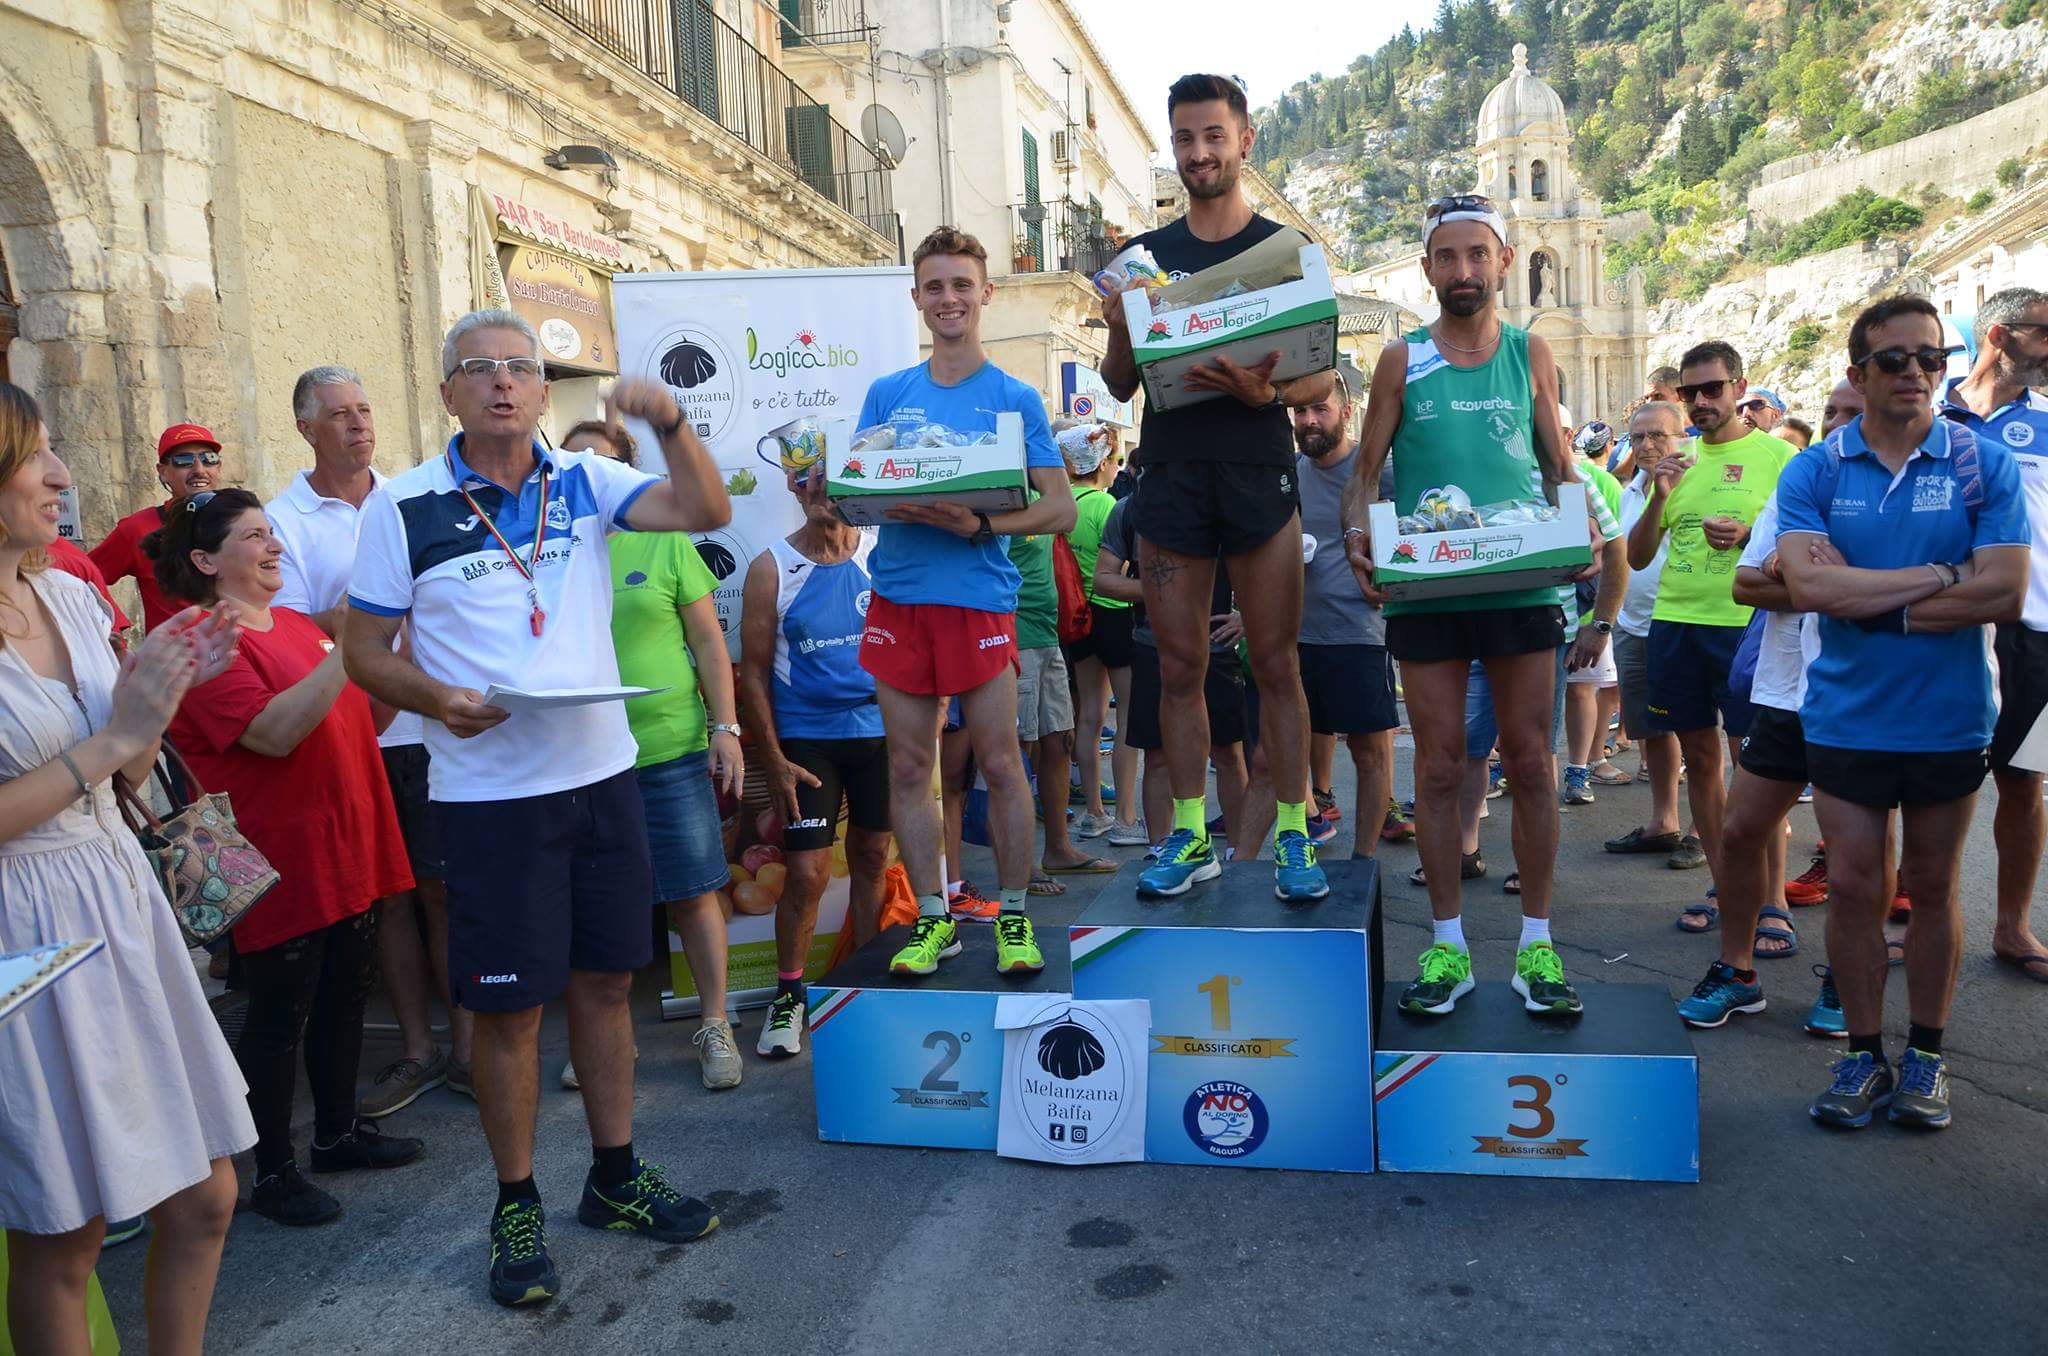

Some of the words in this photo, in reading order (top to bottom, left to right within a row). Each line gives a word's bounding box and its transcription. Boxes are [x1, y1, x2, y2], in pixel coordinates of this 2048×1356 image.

[493, 194, 531, 229] BAR
[514, 276, 537, 299] San
[540, 283, 600, 317] Bartolomeo
[672, 389, 731, 405] lanzana
[794, 387, 840, 408] tutto
[686, 407, 713, 420] affa
[480, 973, 518, 984] LEGEA
[1184, 1042, 1262, 1055] CLASSIFICATO
[1024, 1078, 1119, 1102] Melanzana
[1196, 1083, 1254, 1100] ATLETICA
[914, 1097, 968, 1107] CLASSIFICATO
[1203, 1094, 1250, 1112] NO
[1047, 1103, 1093, 1121] Baffa
[1215, 1111, 1249, 1119] DOPING
[1209, 1145, 1246, 1157] RAGUSA
[1499, 1146, 1564, 1156] CLASSIFICATO
